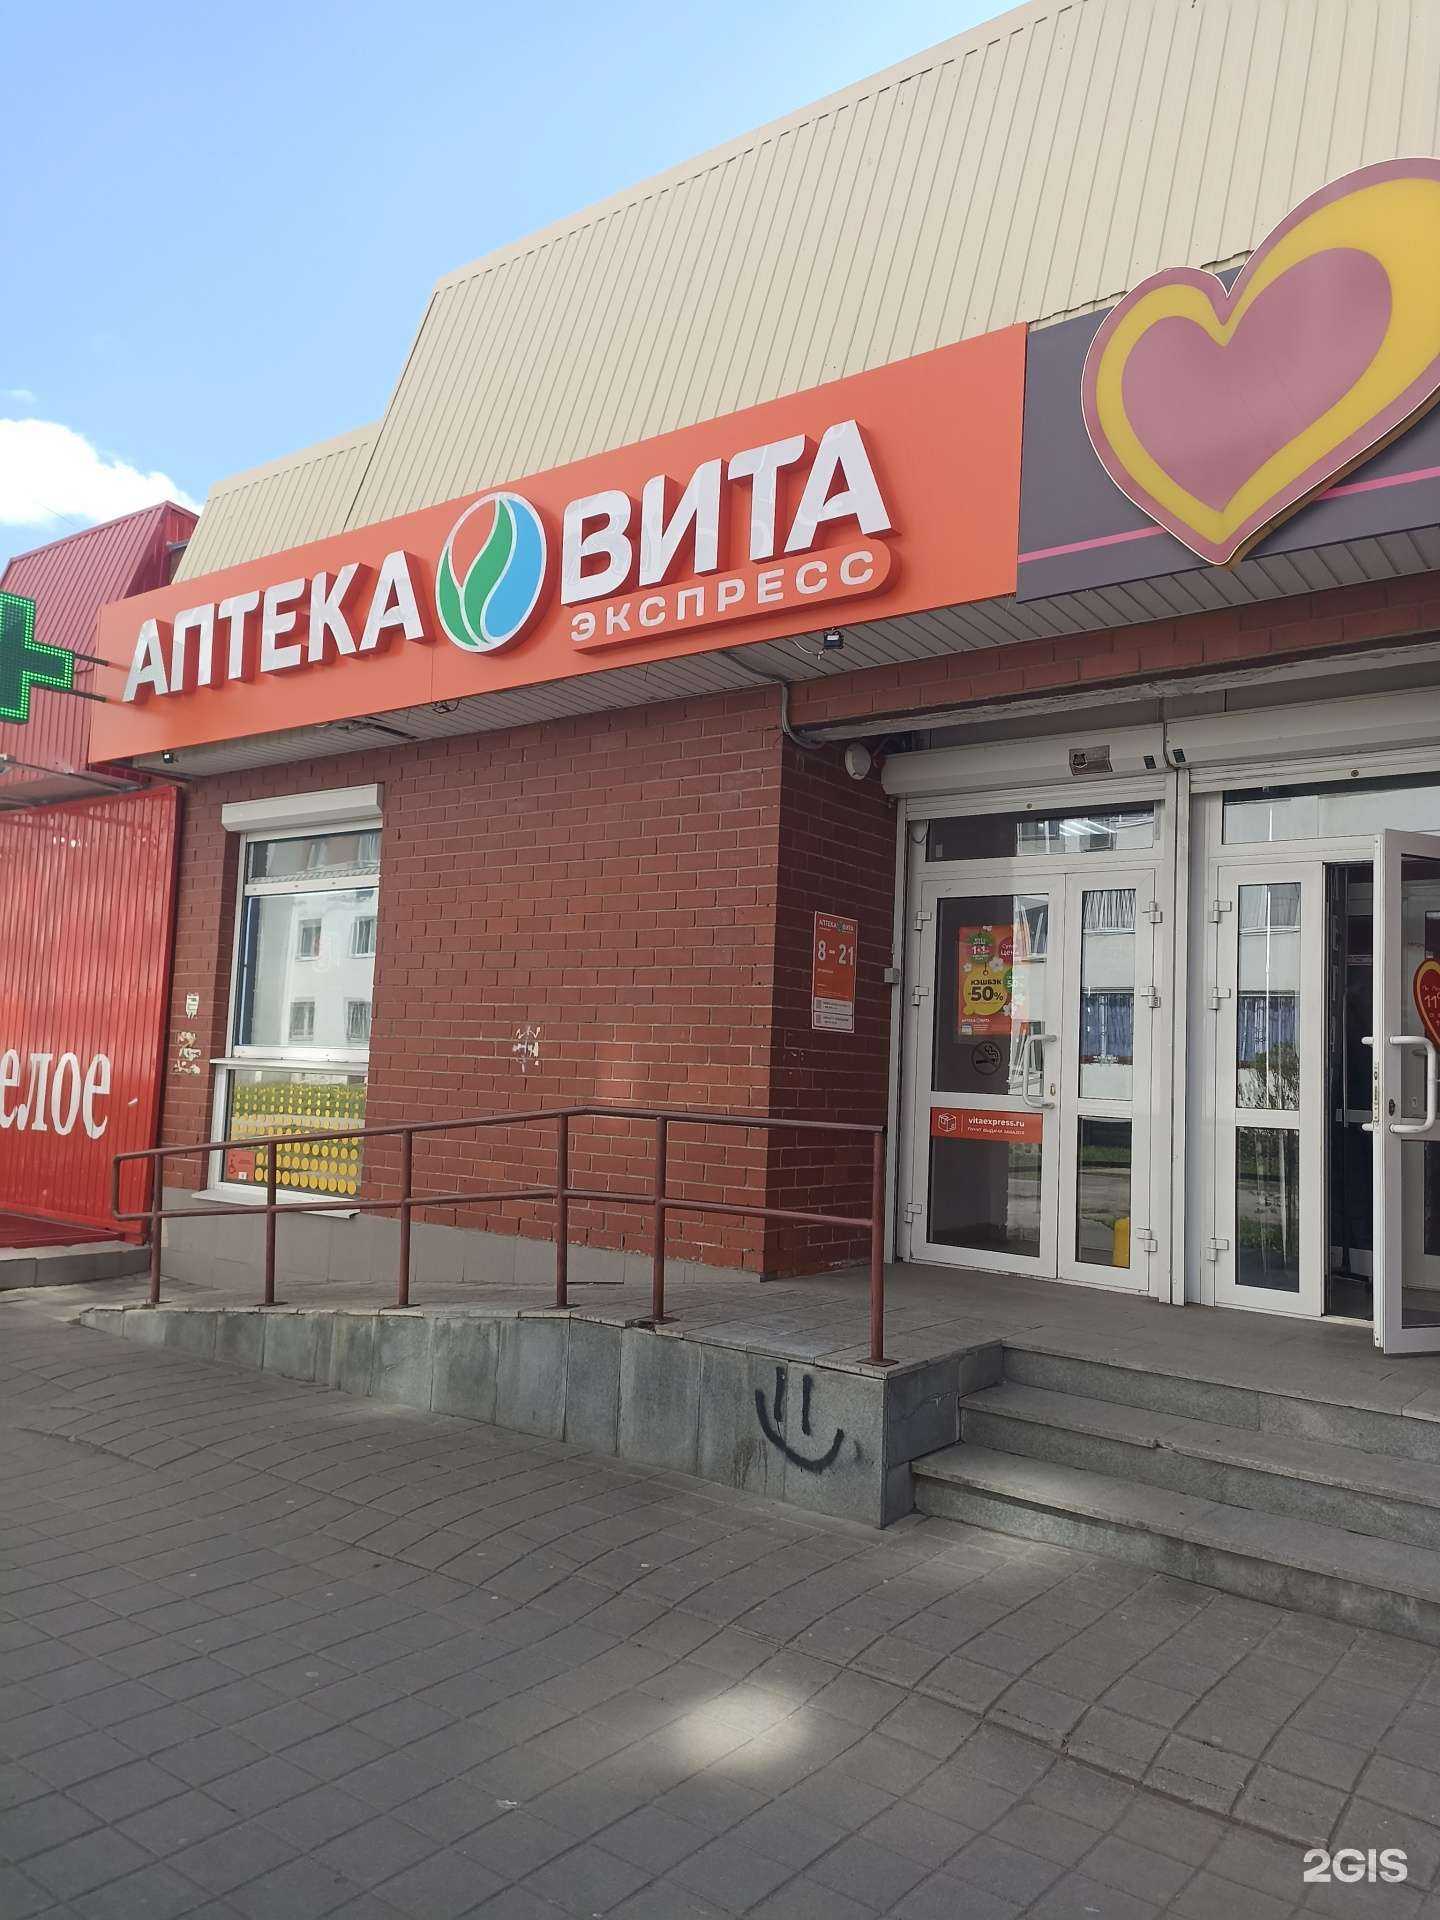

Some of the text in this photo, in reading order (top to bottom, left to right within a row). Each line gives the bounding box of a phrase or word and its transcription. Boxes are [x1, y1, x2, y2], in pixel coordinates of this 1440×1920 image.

[122, 419, 892, 702] АПТЕКА ВИТА
[571, 550, 875, 642] ЭКСПРЕСС
[818, 940, 854, 966] 8 21
[968, 1116, 1025, 1127] vitaexpress.ru
